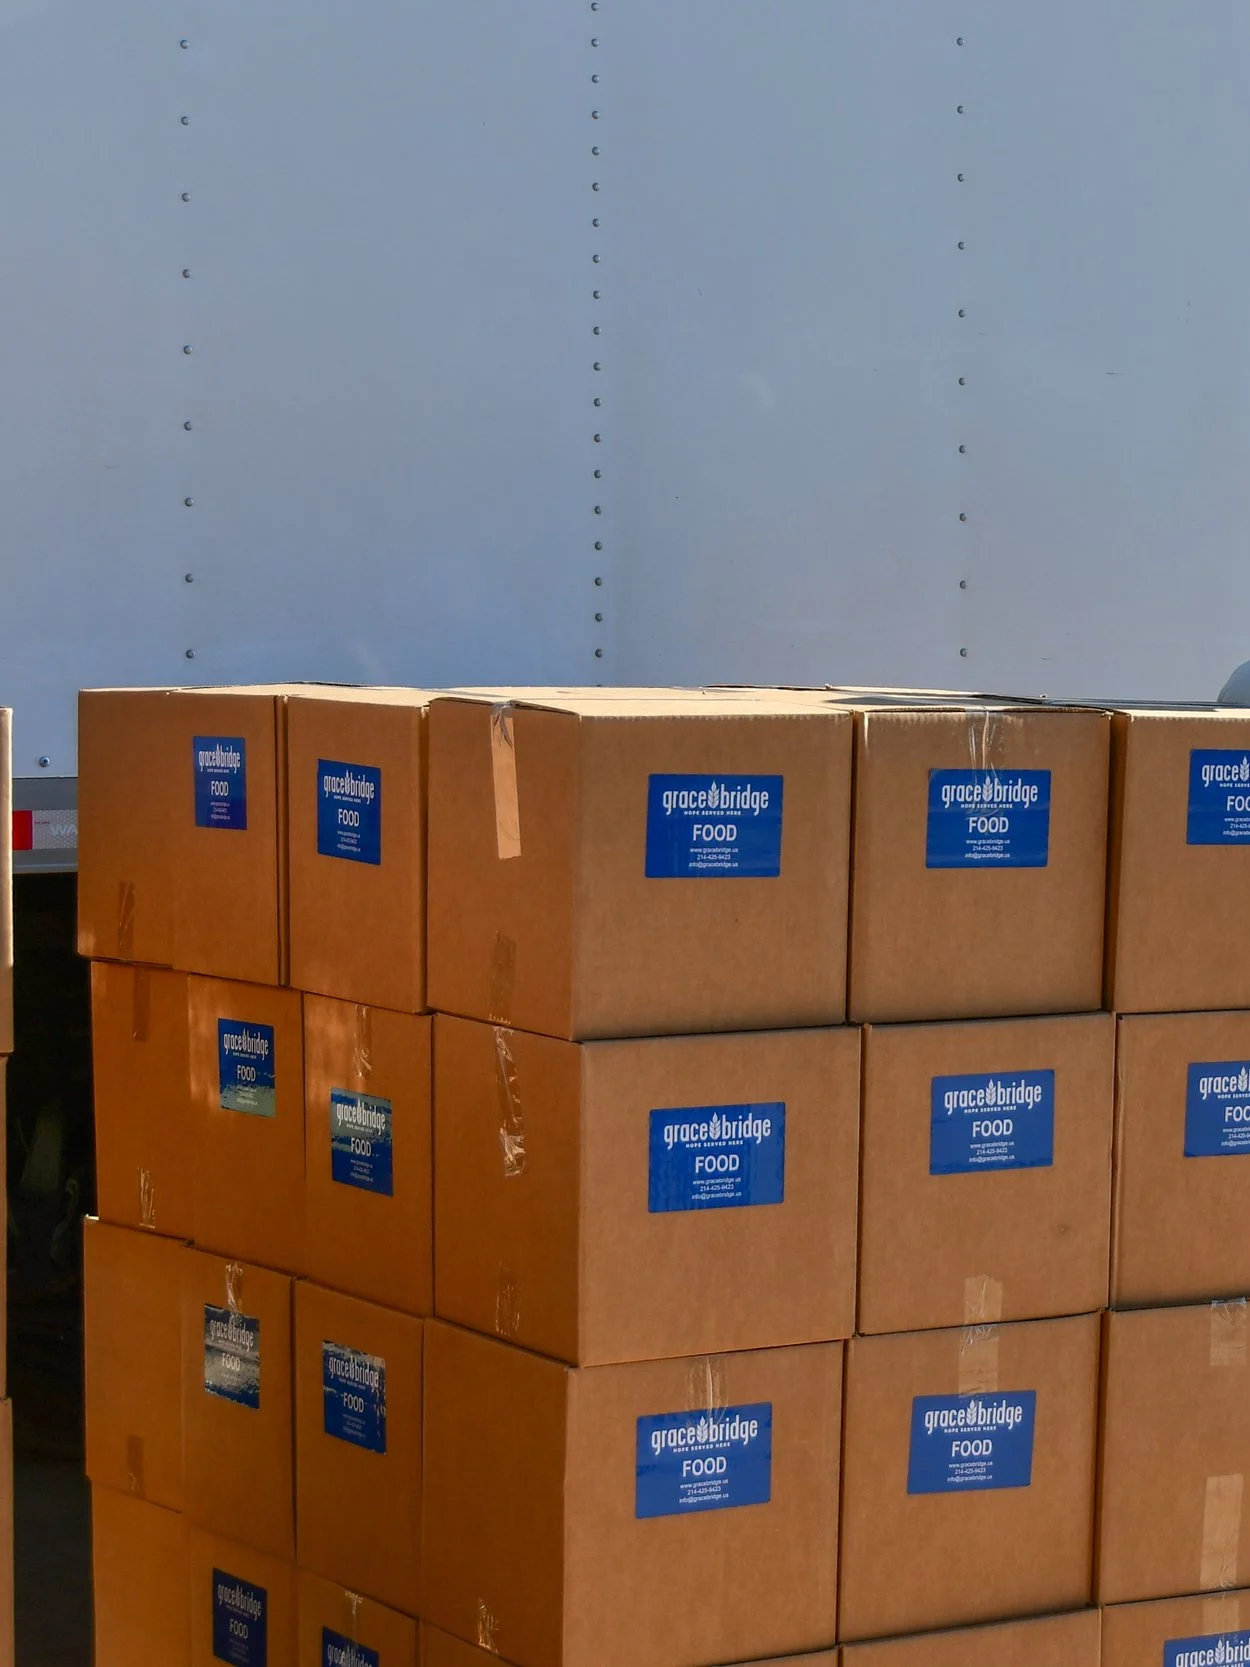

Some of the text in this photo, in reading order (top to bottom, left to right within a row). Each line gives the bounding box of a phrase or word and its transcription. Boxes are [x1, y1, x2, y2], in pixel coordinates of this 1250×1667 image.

[211, 781, 228, 796] FOOD
[338, 809, 359, 826] FOOD
[969, 817, 1008, 832] FOOD
[693, 825, 737, 841] FOOD
[237, 1065, 256, 1081] FOOD
[972, 1119, 1013, 1137] FOOD
[351, 1137, 371, 1156] FOOD
[695, 1155, 739, 1173] FOOD
[222, 1353, 240, 1371] FOOD
[344, 1392, 364, 1412] FOOD
[952, 1439, 992, 1457] FOOD
[683, 1457, 726, 1477] FOOD
[230, 1619, 248, 1639] FOOD
